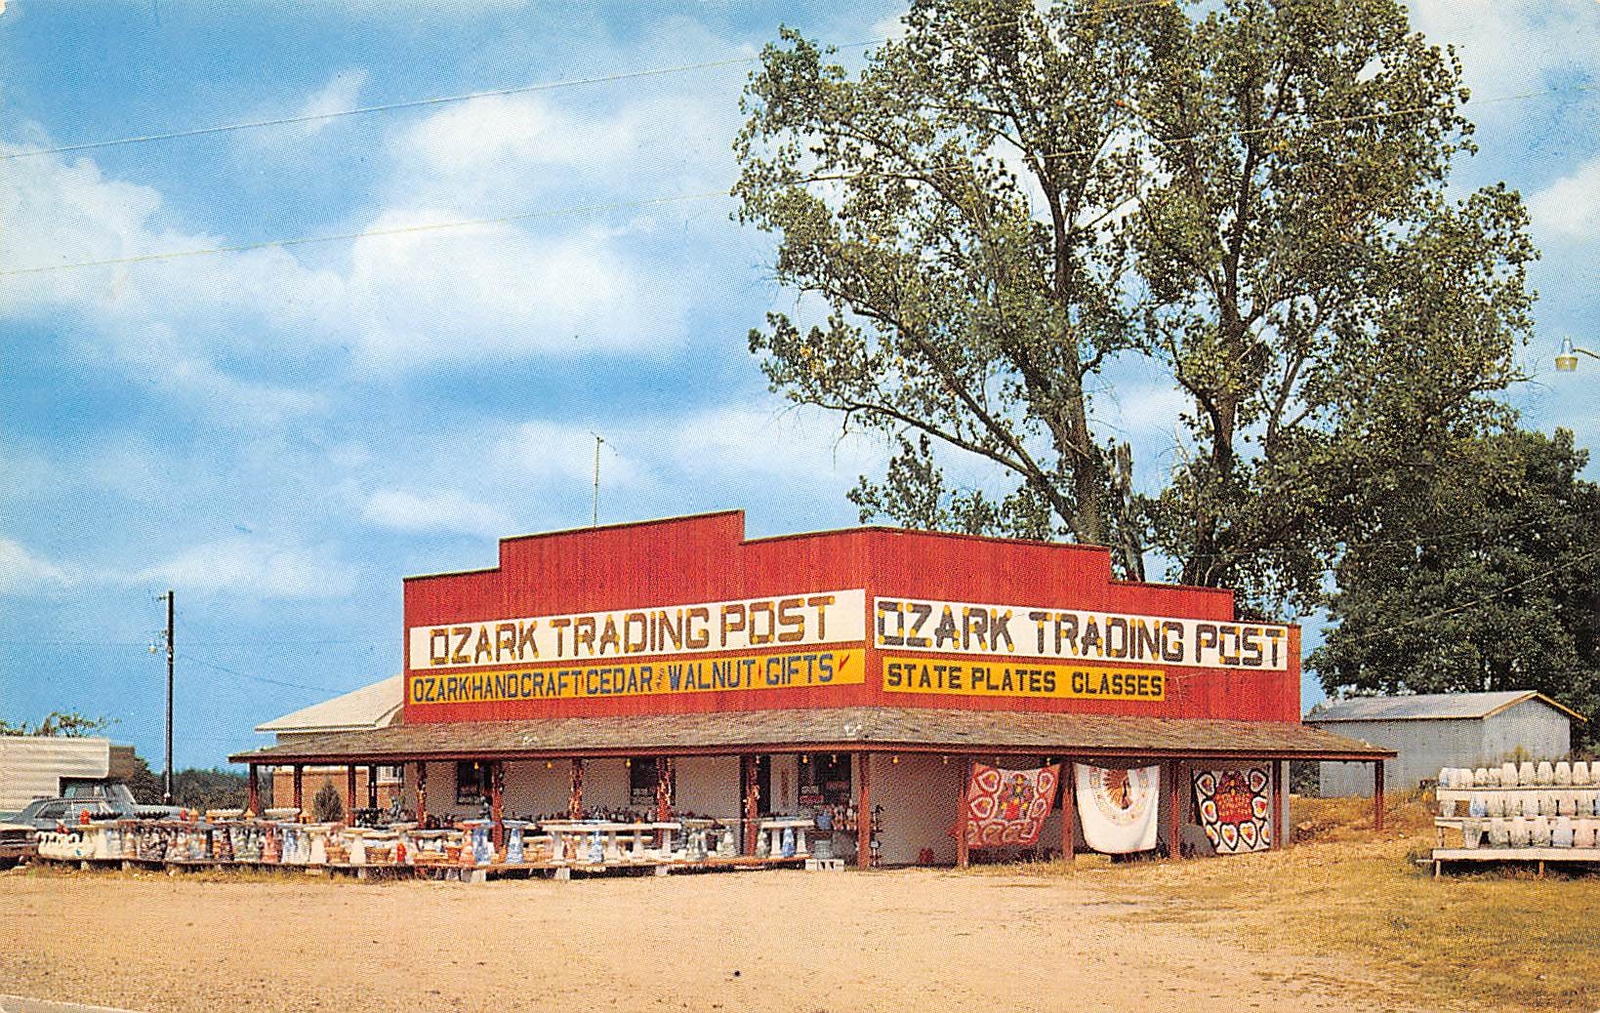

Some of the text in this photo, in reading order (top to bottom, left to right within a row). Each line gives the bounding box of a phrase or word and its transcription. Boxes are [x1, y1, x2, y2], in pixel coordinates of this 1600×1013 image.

[430, 595, 834, 666] OZARK TRADING POST
[877, 601, 1285, 667] OZARK TRADING POST
[586, 666, 653, 694] CEDAR
[667, 659, 756, 691] WALNUT
[765, 653, 834, 685] GIFTS
[888, 663, 1163, 697] STATE PLATES GLASSES
